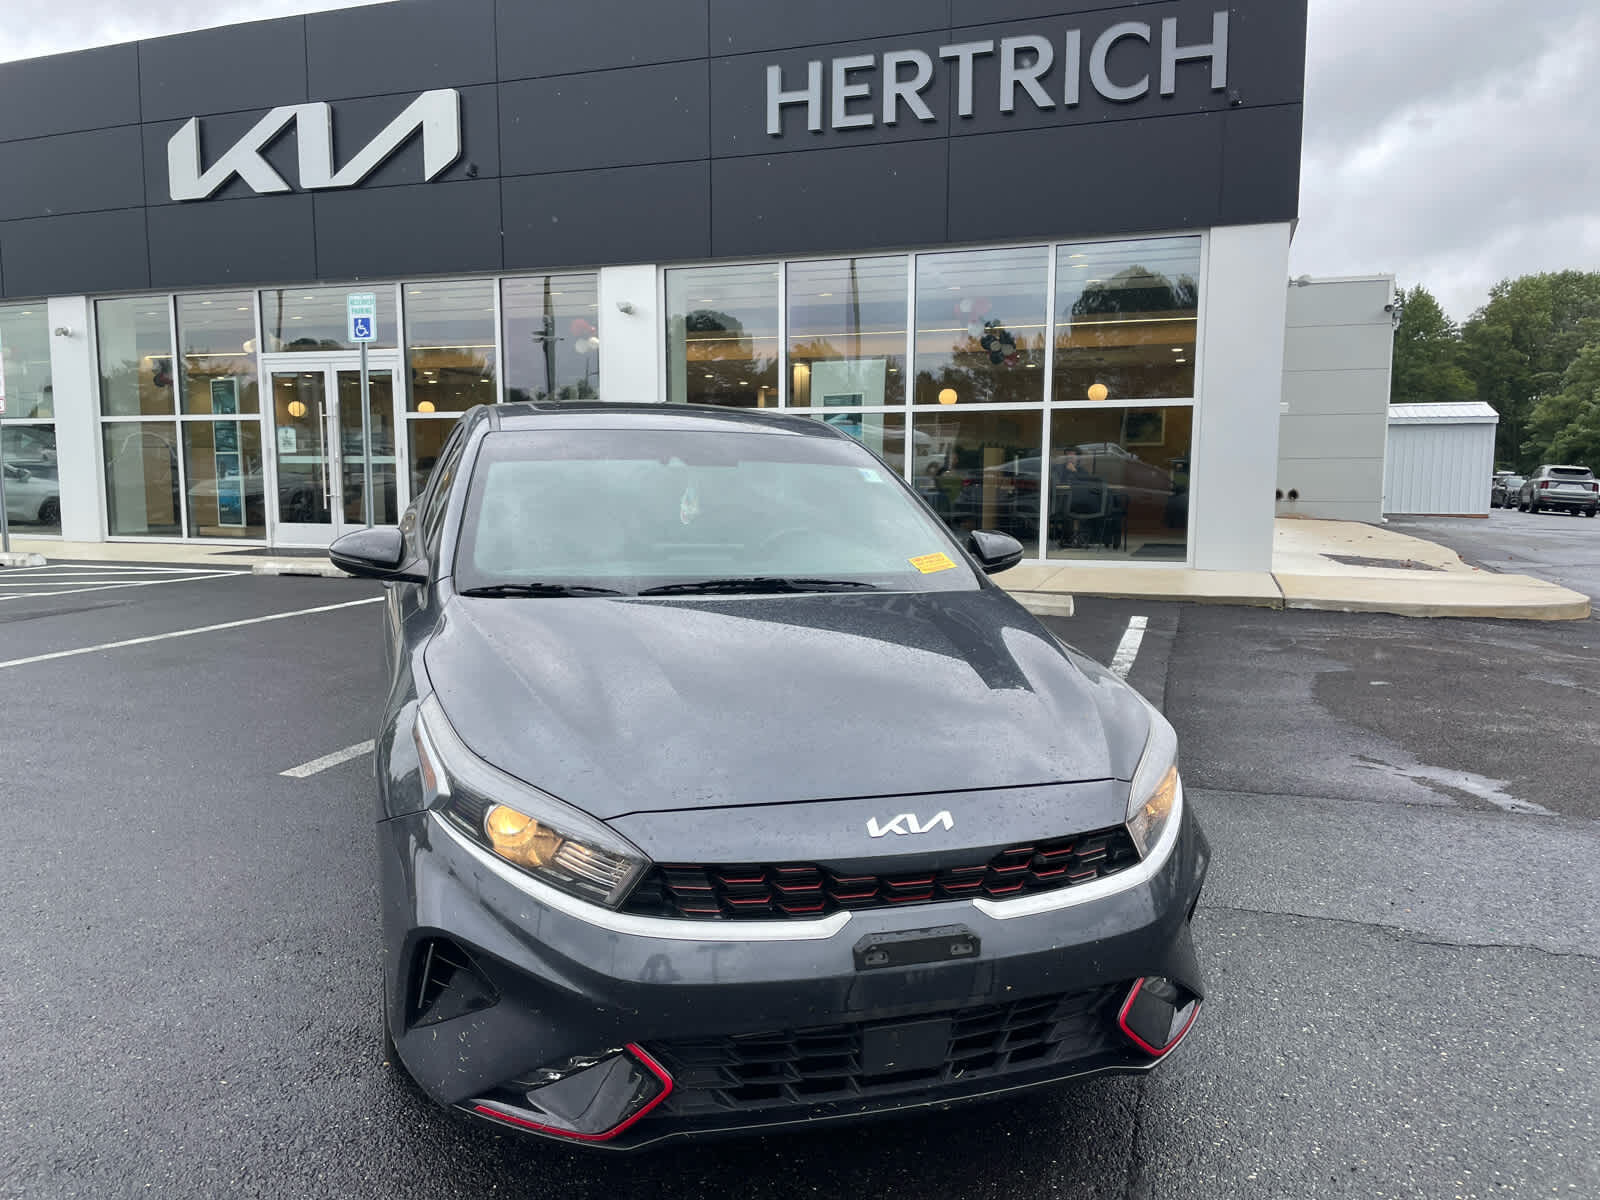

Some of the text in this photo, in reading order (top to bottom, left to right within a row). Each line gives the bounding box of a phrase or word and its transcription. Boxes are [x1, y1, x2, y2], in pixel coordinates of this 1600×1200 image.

[766, 10, 1229, 137] HERTRICH
[167, 88, 460, 201] KIA
[866, 810, 954, 838] KIA
